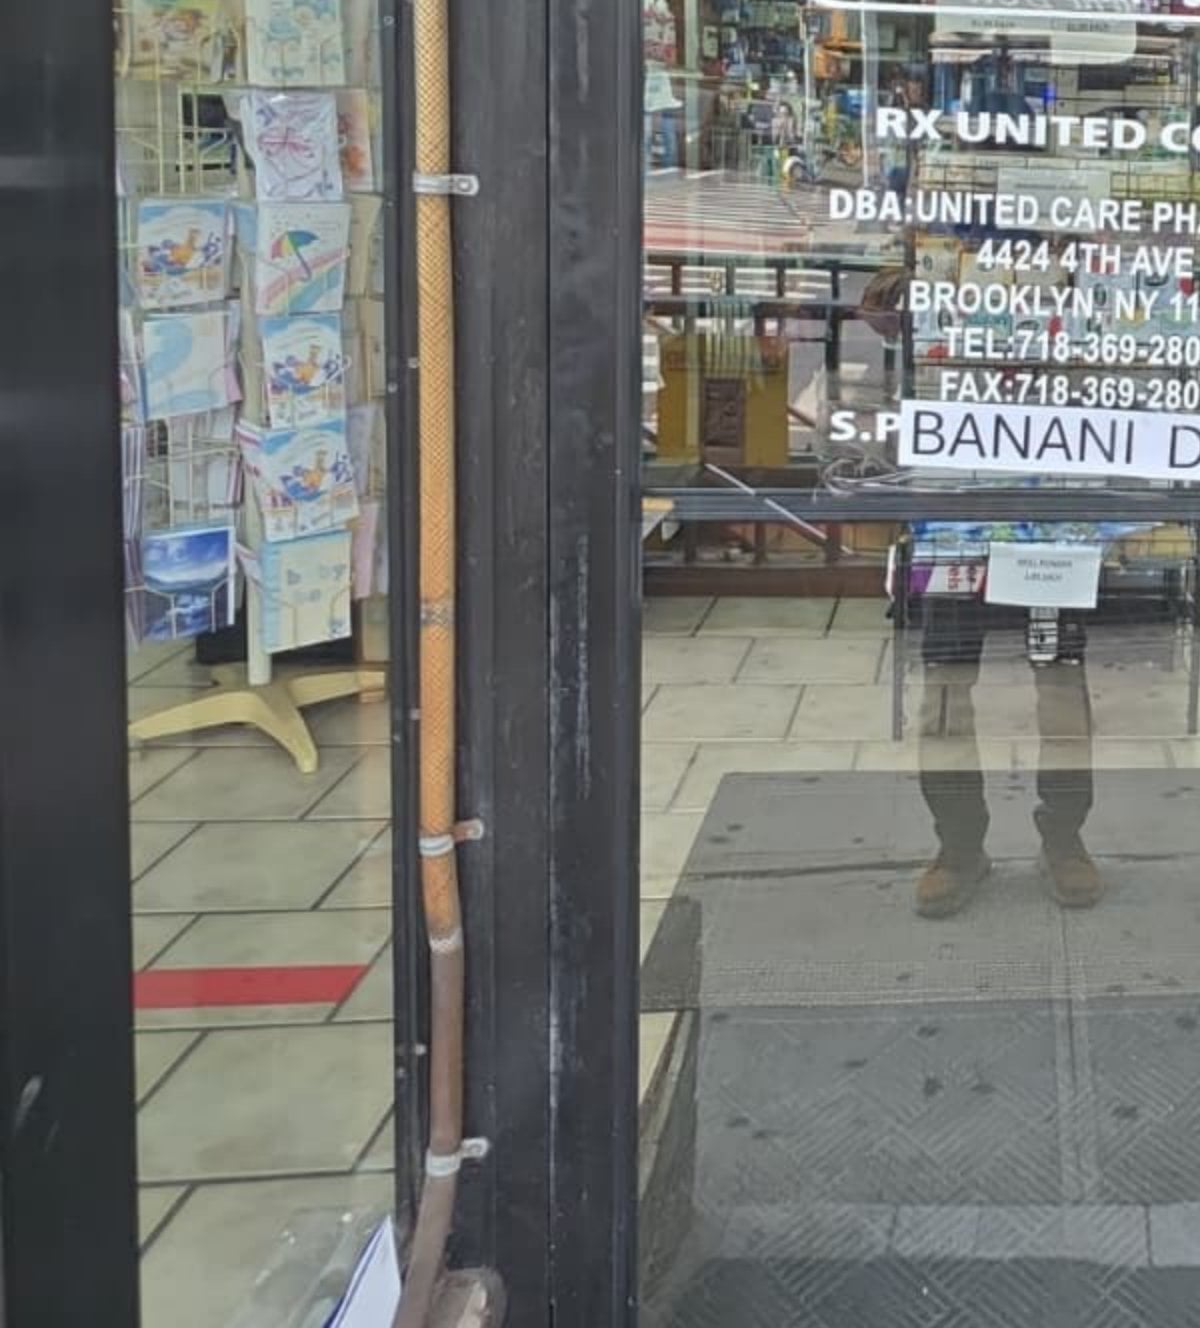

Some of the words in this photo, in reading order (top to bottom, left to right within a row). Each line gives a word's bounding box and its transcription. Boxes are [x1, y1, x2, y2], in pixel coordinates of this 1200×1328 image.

[875, 108, 941, 142] RX
[956, 111, 1146, 152] UNITED
[829, 189, 1038, 225] DBA:UNITED
[1050, 196, 1141, 233] CARE
[976, 238, 1051, 272] 4424
[1060, 242, 1122, 275] 4TH
[1131, 246, 1196, 279] AVE
[909, 280, 1103, 322] BROOKLYN,
[1114, 289, 1159, 322] NY
[911, 409, 1134, 466] BANANI
